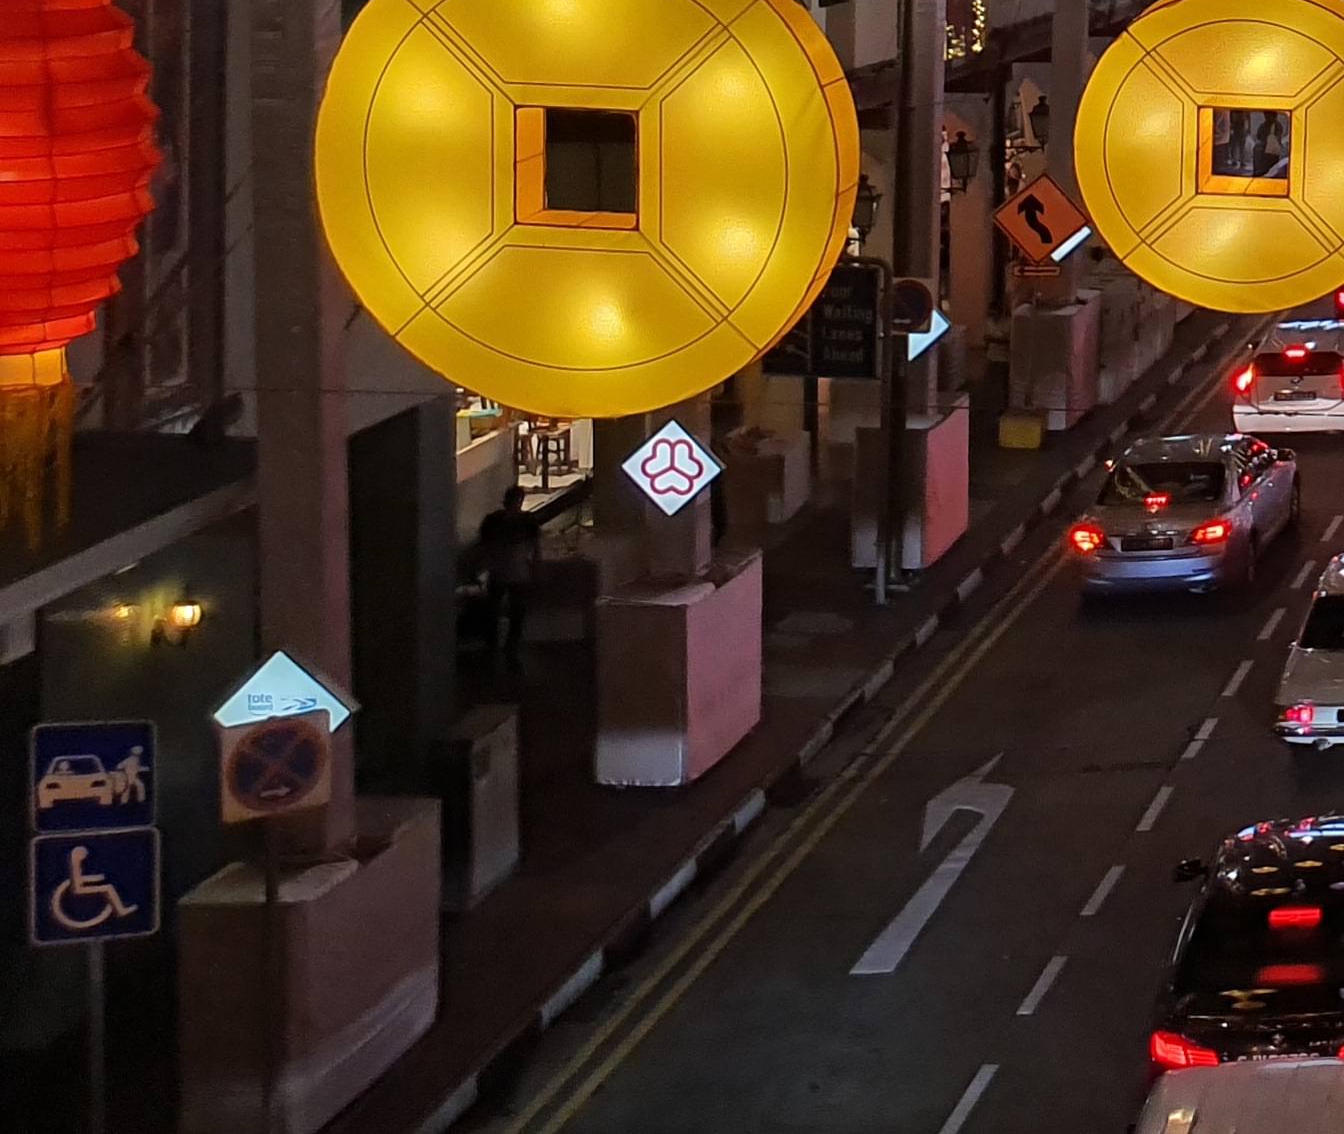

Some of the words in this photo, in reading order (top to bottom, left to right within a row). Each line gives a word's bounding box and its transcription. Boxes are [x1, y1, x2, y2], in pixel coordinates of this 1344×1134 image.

[822, 304, 873, 324] Waiting
[822, 326, 864, 341] Lanes
[822, 347, 864, 362] Ahead
[247, 694, 273, 703] tote
